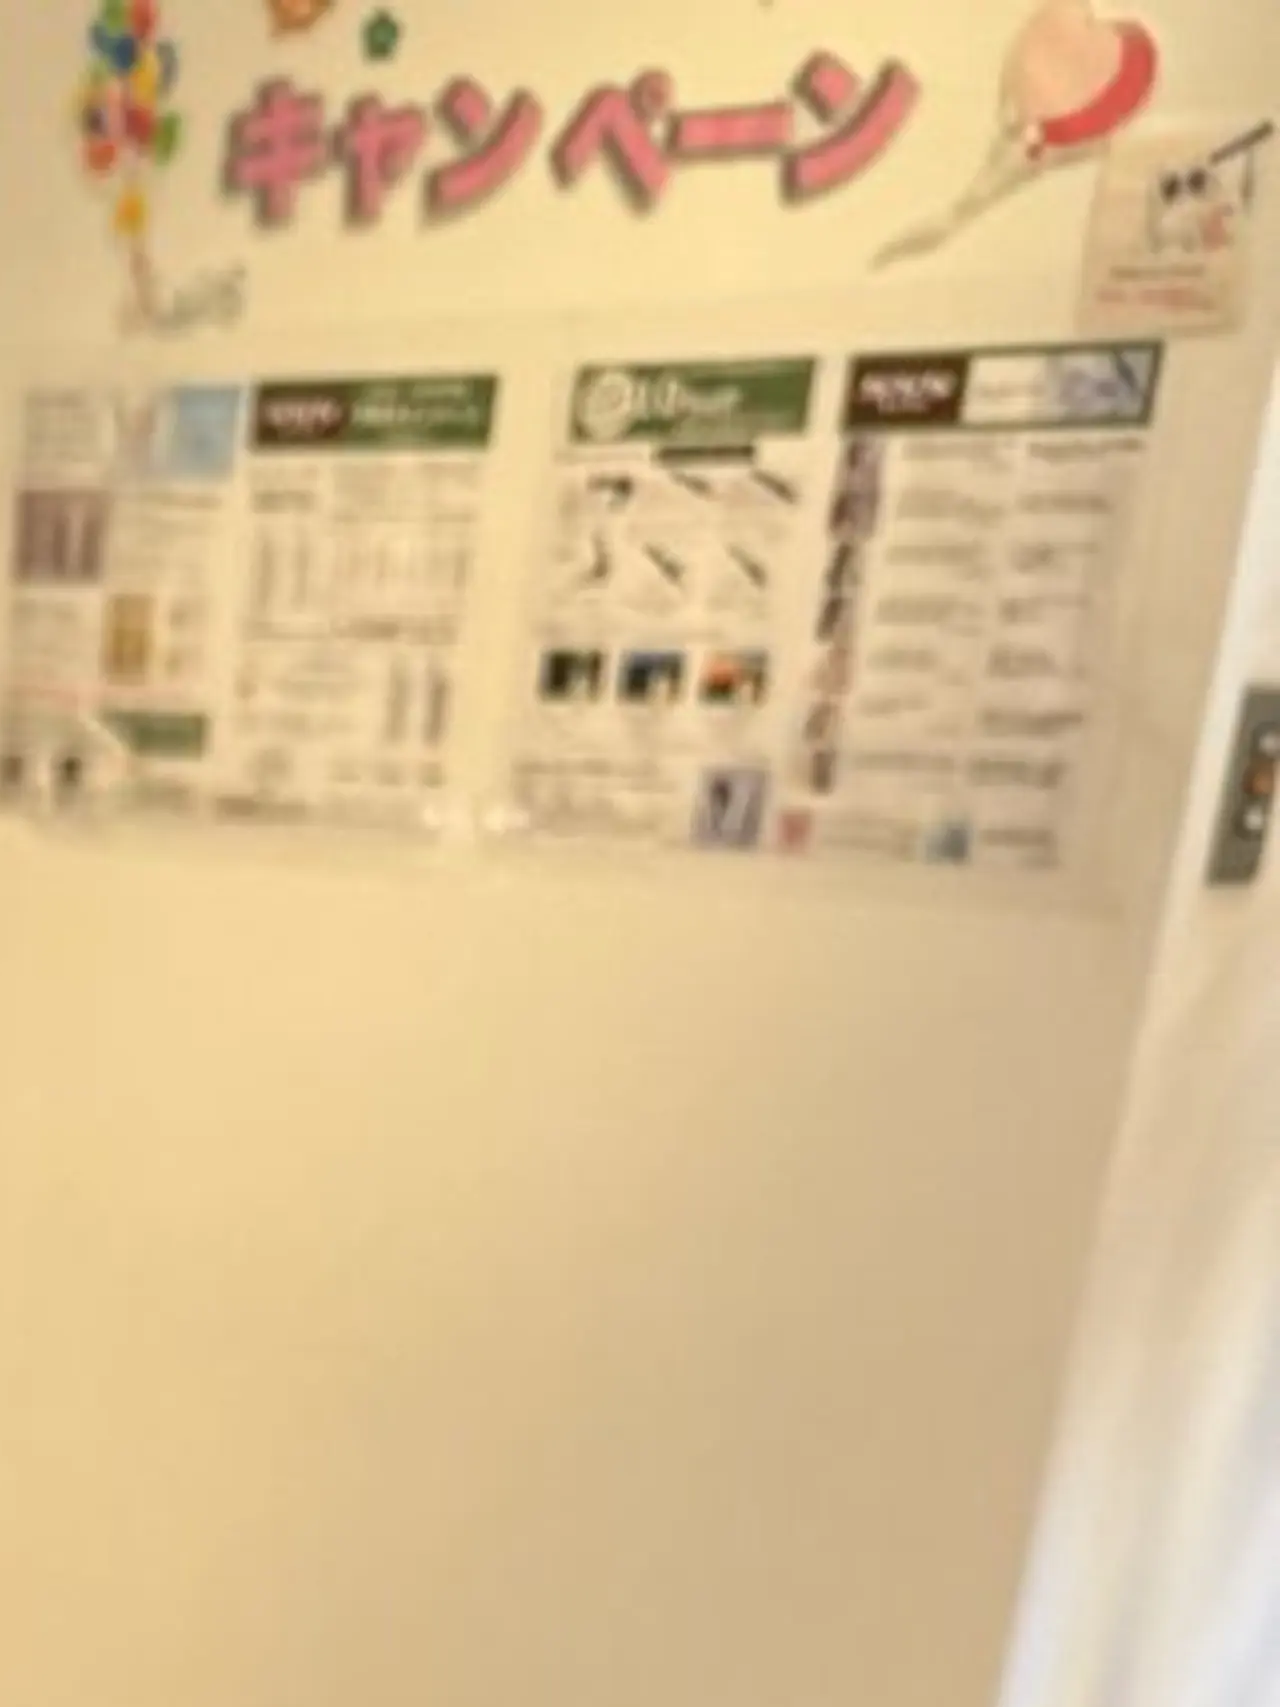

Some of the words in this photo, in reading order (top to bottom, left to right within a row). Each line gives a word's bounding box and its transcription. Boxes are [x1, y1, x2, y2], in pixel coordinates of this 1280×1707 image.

[223, 50, 920, 230] キャンペーン
